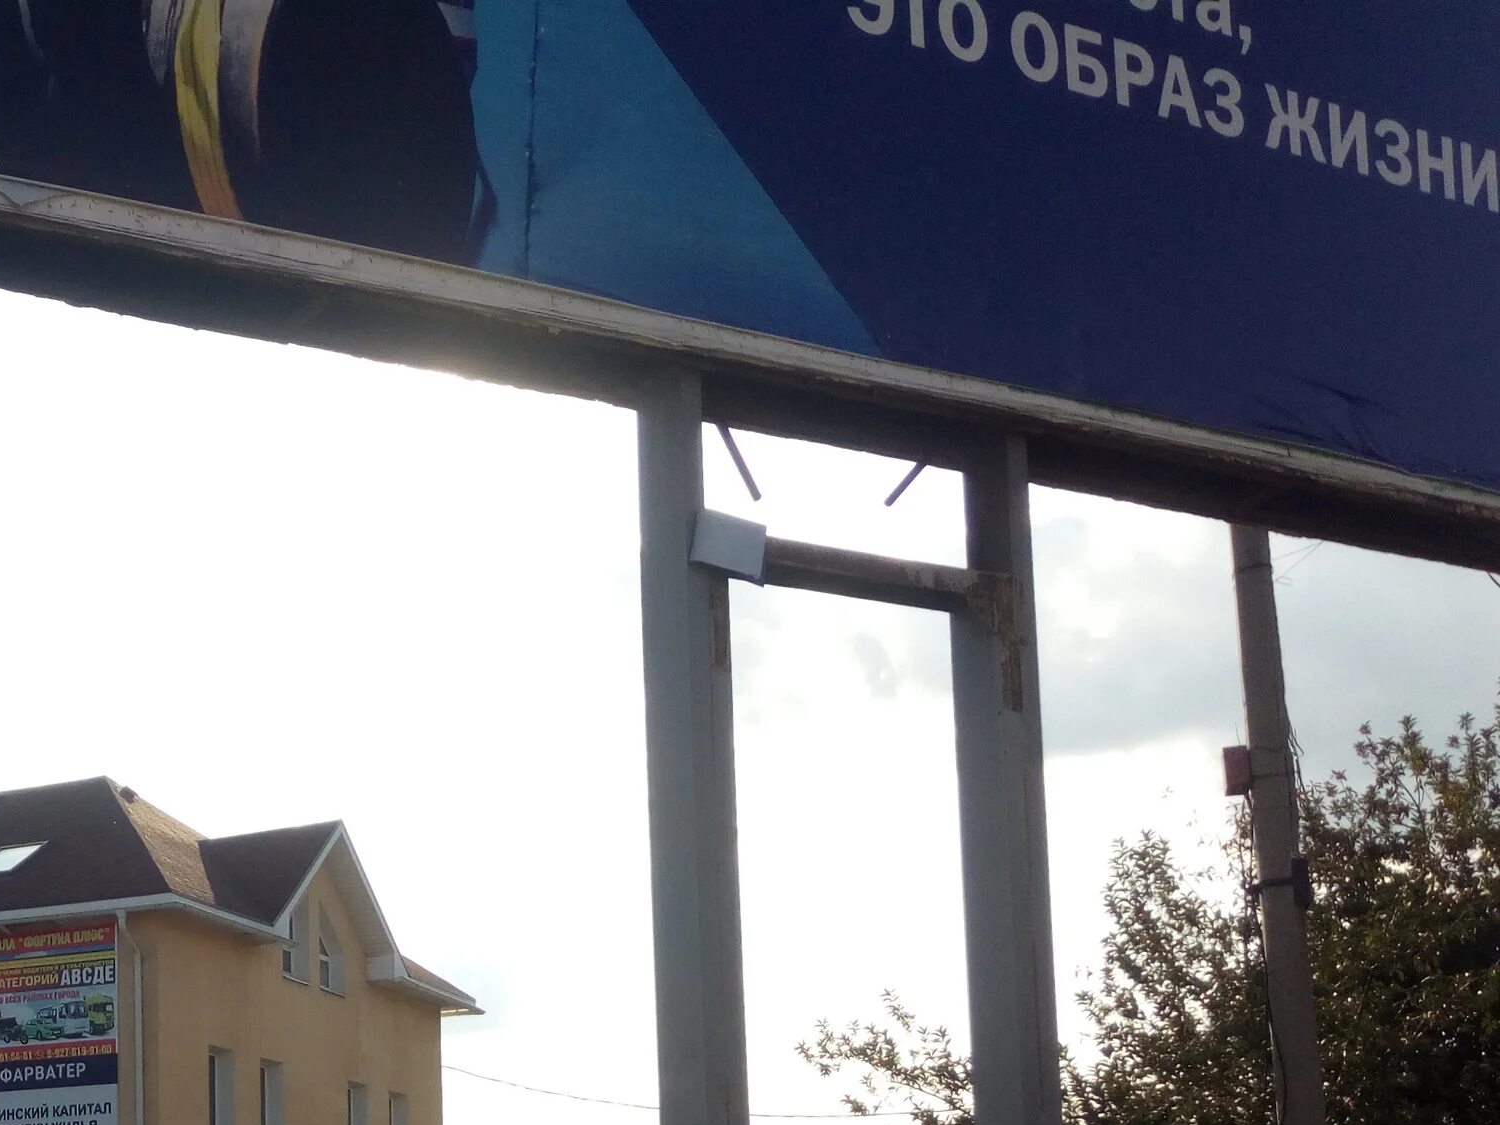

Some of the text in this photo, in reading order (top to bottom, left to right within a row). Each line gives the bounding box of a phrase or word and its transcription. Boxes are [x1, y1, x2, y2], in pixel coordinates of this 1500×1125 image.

[1011, 11, 1245, 138] ОБРАЗ
[1264, 83, 1500, 212] ЖИЗНИ
[0, 1062, 86, 1084] ФАРВАТЕР
[52, 1102, 112, 1118] КАПИТАЛ
